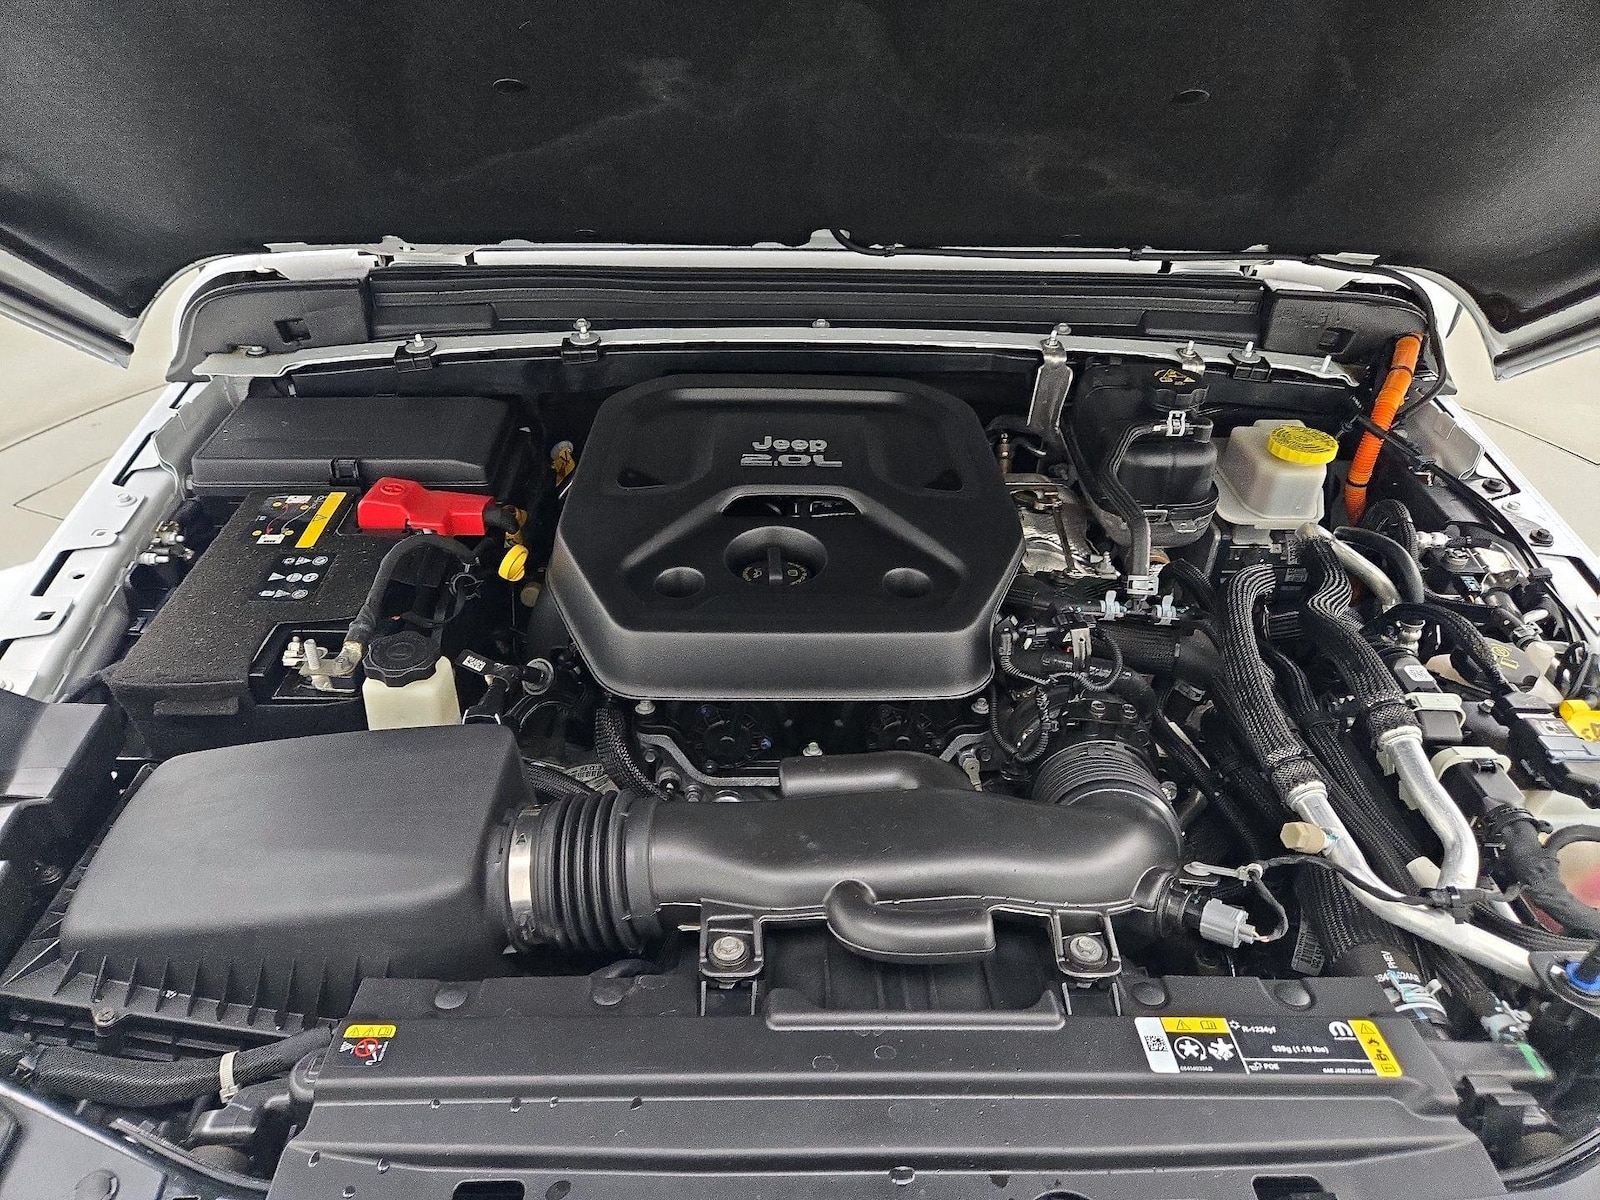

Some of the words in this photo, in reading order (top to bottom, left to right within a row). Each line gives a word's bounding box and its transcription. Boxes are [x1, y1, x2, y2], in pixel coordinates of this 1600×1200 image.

[752, 435, 828, 453] Jeep
[740, 453, 843, 468] 2.0L
[1380, 950, 1399, 969] PHEV
